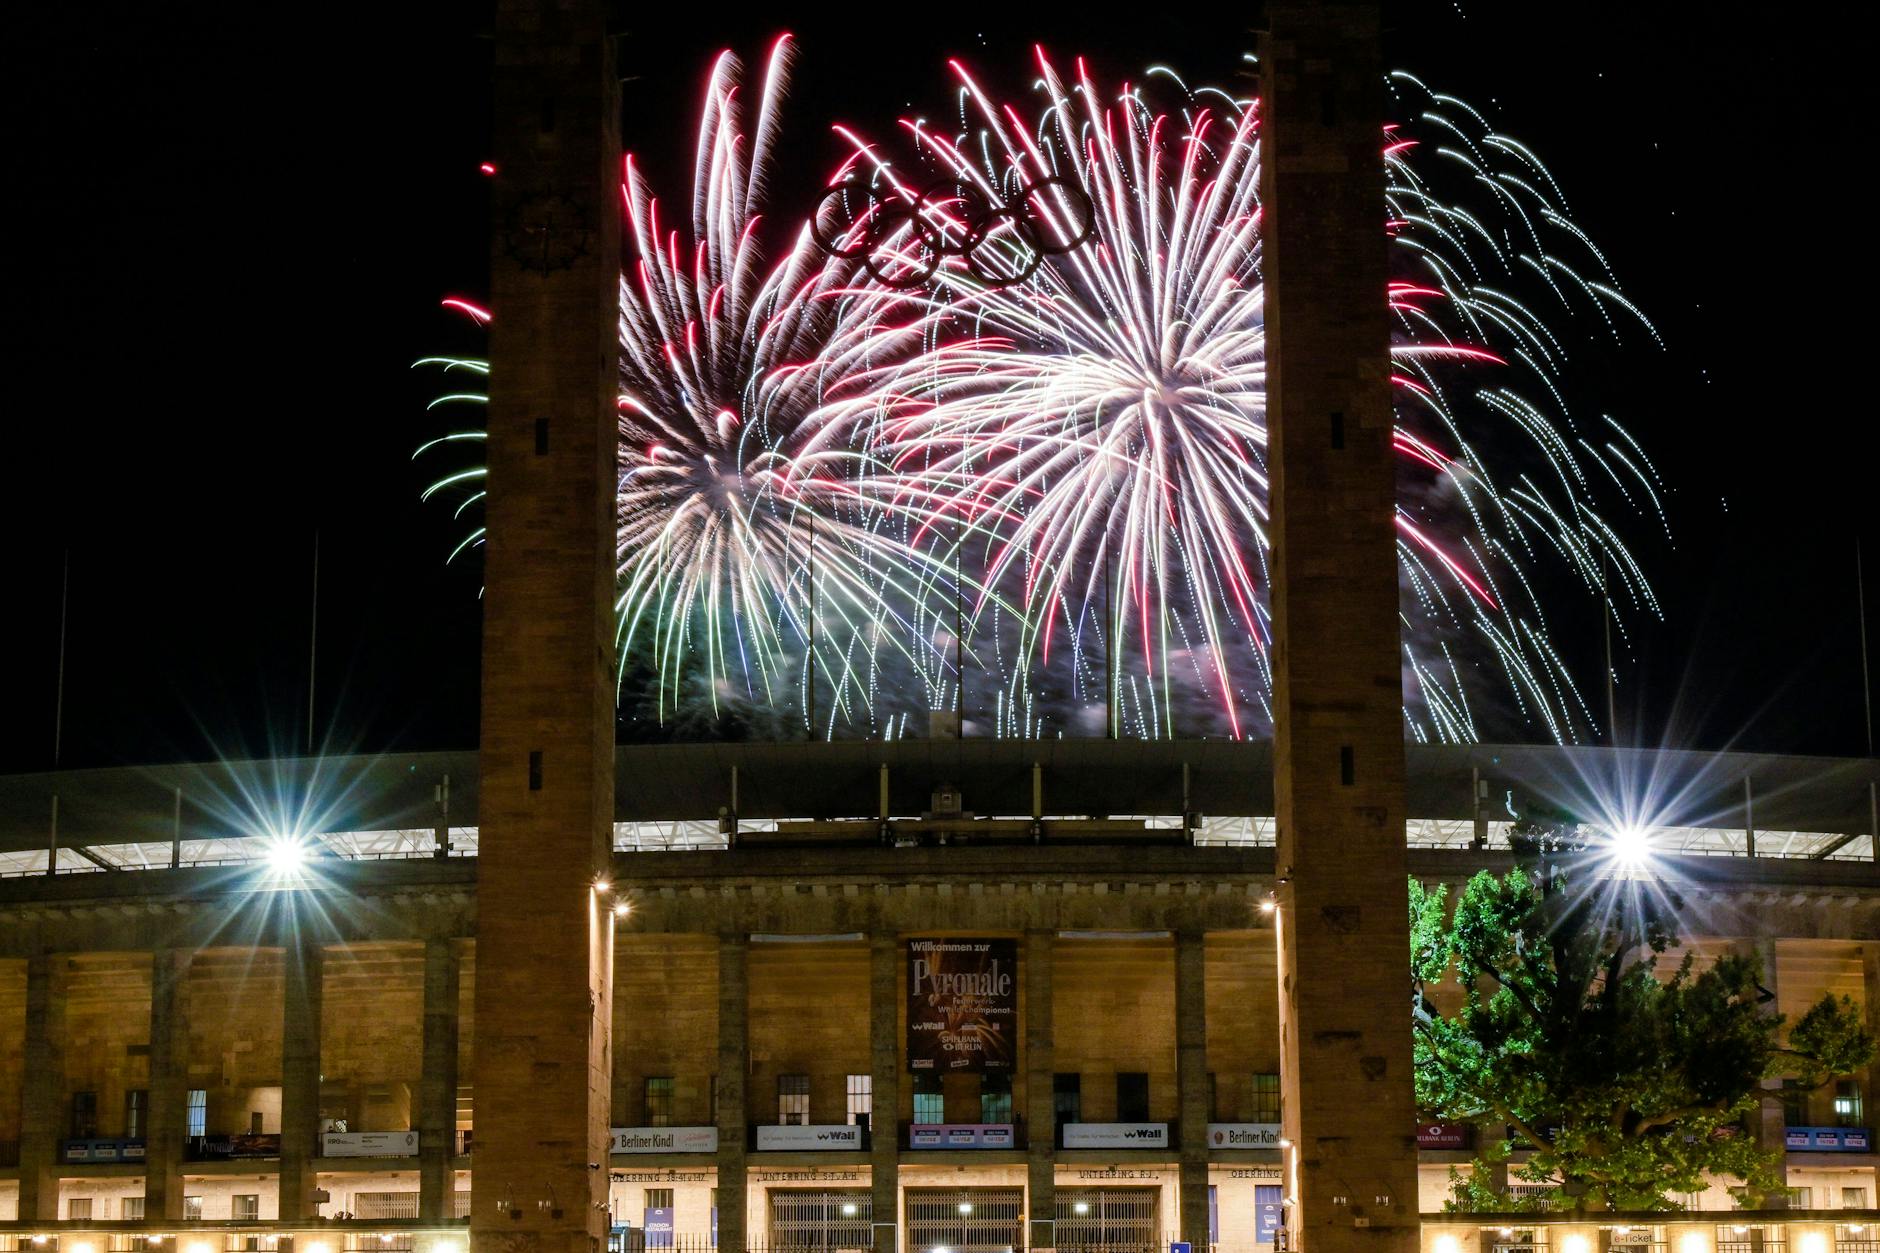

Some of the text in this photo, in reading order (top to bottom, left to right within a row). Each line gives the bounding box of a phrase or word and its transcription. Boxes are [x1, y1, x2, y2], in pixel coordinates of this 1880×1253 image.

[911, 941, 991, 952] Willkommen zur
[912, 958, 1011, 1006] Pyronale
[922, 1022, 945, 1030] Wall
[955, 1043, 982, 1051] BERLIN
[829, 1131, 856, 1140] Wall
[1136, 1129, 1162, 1138] Wall
[1229, 1130, 1260, 1144] Berliner
[621, 1134, 652, 1148] Berliner
[653, 1134, 674, 1147] Kindl
[613, 1173, 660, 1183] OBERRING
[762, 1172, 817, 1181] UNTERRING
[1079, 1170, 1134, 1179] UNTERRING
[1231, 1170, 1280, 1178] OBERRING
